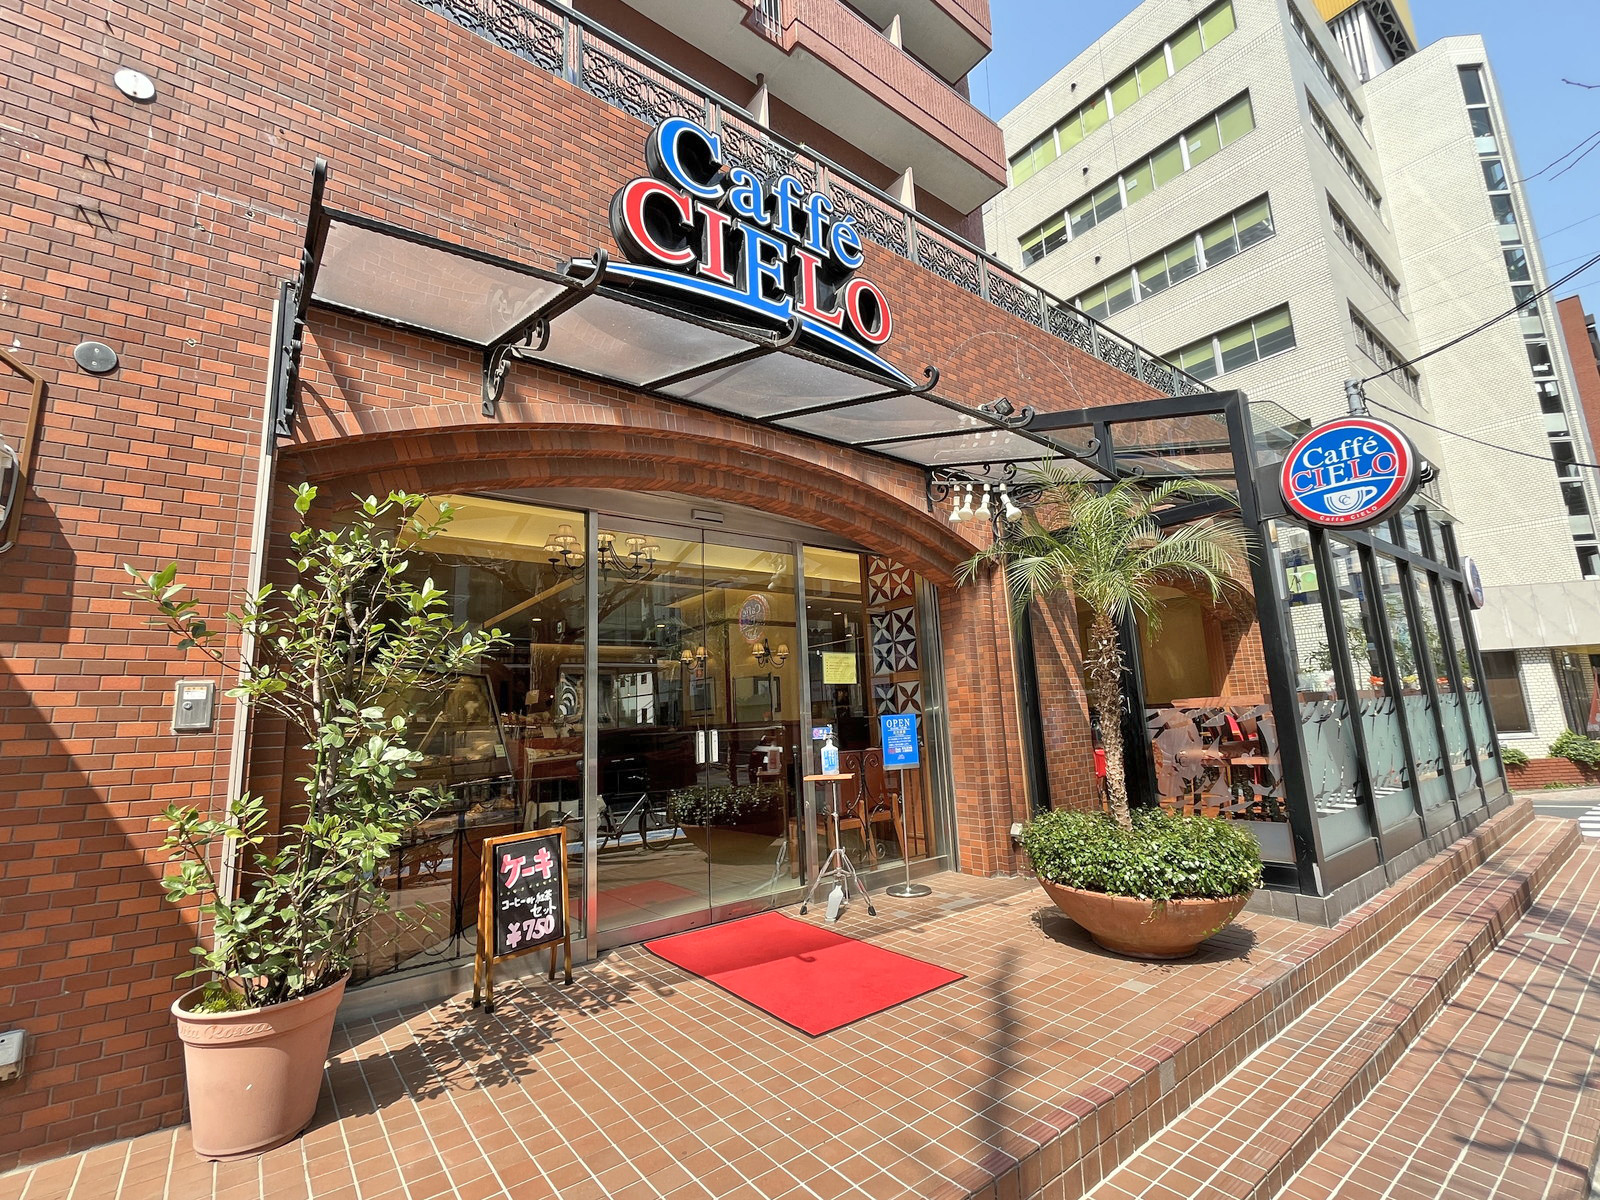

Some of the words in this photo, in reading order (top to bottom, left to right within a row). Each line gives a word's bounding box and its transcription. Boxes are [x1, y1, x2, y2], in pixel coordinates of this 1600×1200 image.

[656, 115, 865, 270] Caffé
[619, 176, 893, 345] CIELO
[1302, 435, 1379, 469] Caffé
[1291, 451, 1398, 493] CIELO
[1350, 505, 1378, 520] CIELO
[885, 718, 911, 729] OPEN
[500, 846, 554, 889] ケーキ
[529, 898, 557, 918] セット
